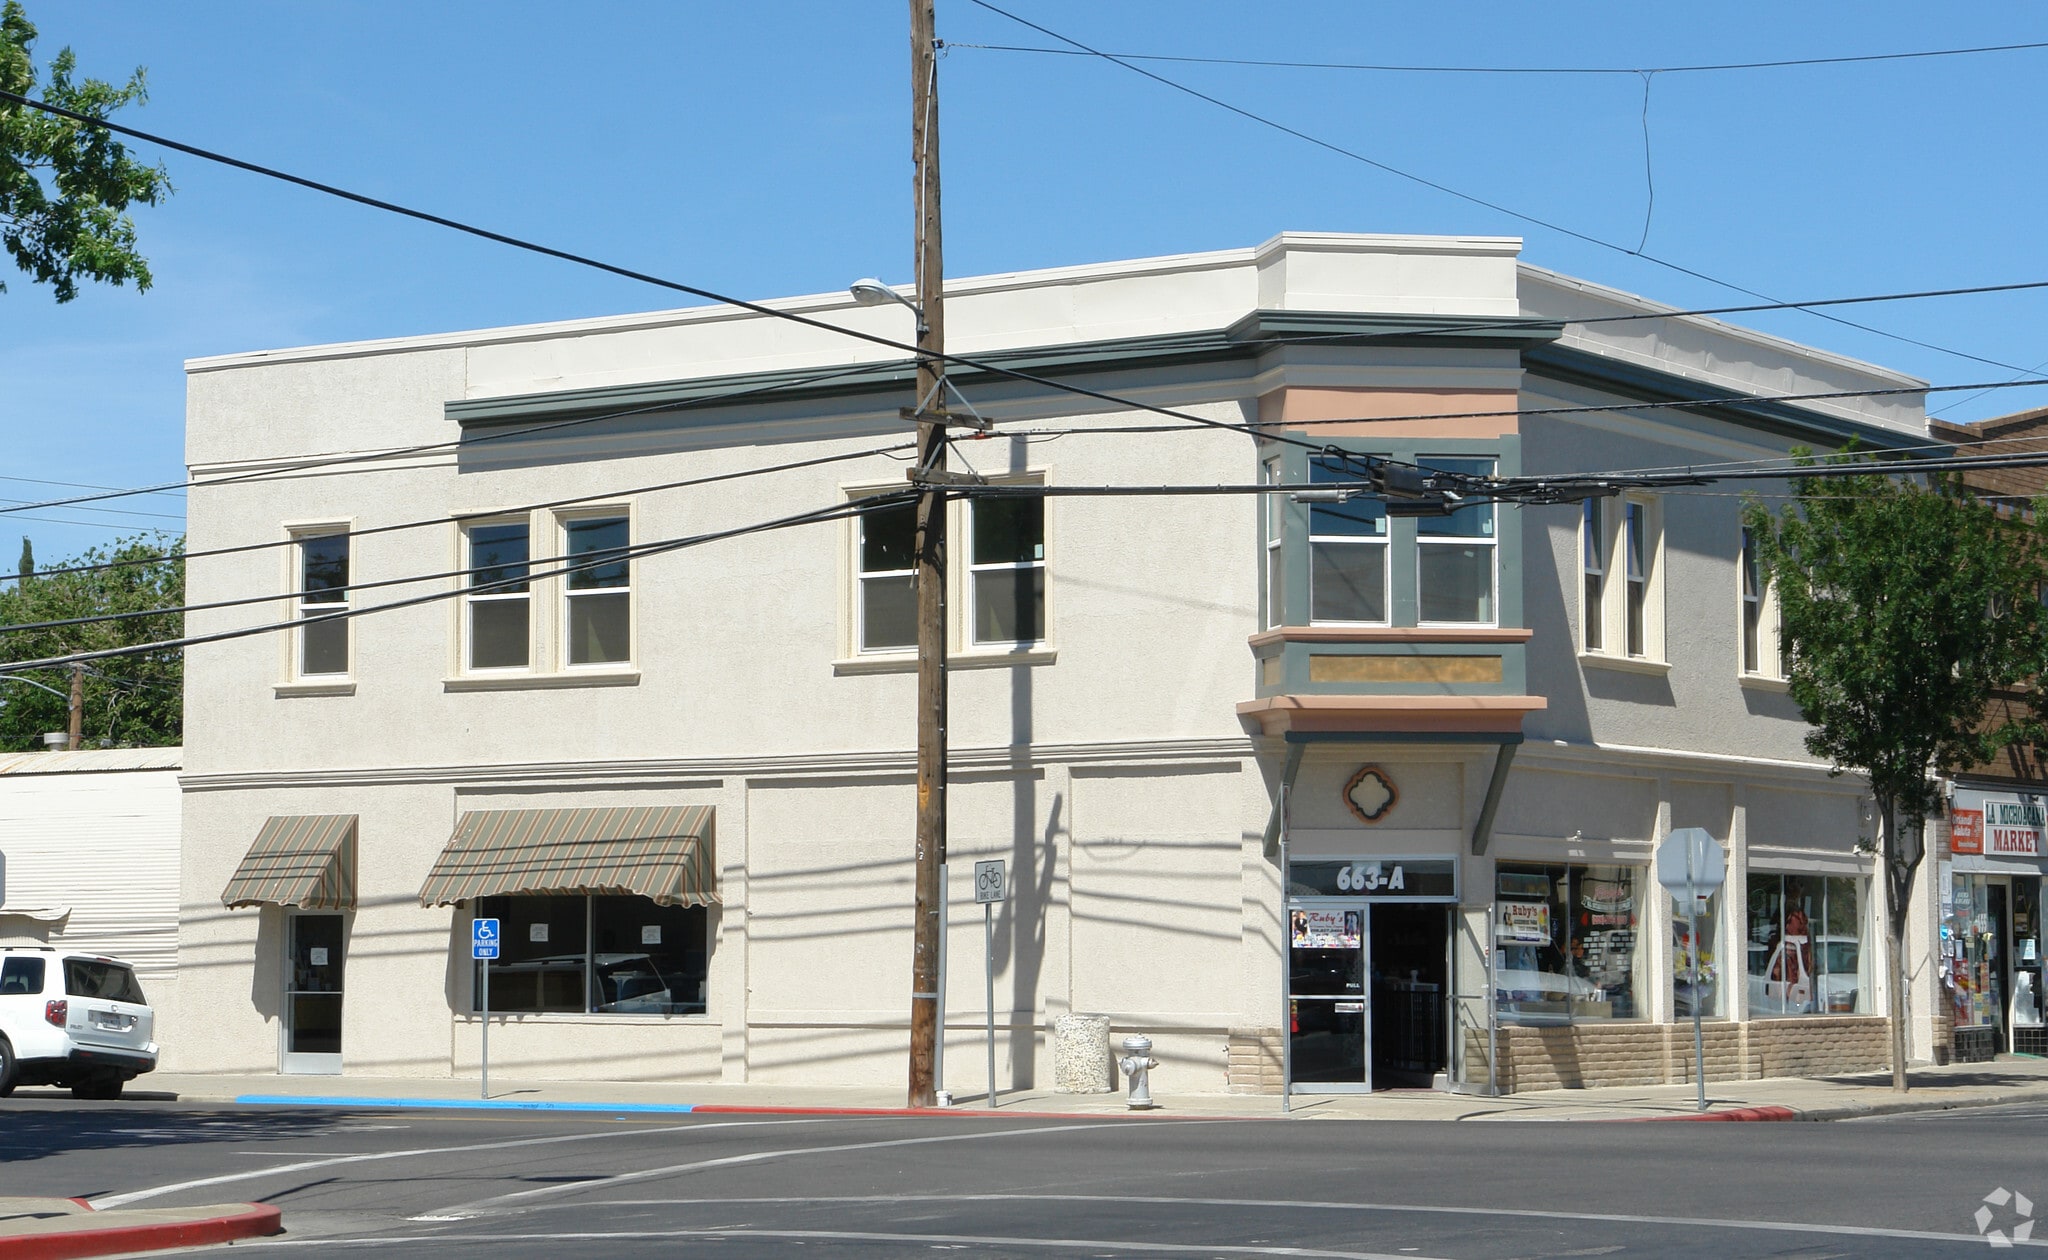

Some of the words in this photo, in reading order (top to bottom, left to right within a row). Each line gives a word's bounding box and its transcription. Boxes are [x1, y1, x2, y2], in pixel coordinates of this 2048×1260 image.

[1986, 803, 1996, 825] LA
[1999, 804, 2046, 828] MICHOACANA
[1993, 829, 2040, 853] MARKET
[1336, 866, 1405, 891] 663-A
[980, 890, 990, 900] BIKE
[990, 889, 1001, 899] LANE
[1309, 911, 1344, 925] Ruby's
[1511, 904, 1538, 919] Ruby's
[473, 939, 499, 947] PARKING
[478, 948, 493, 956] ONLY
